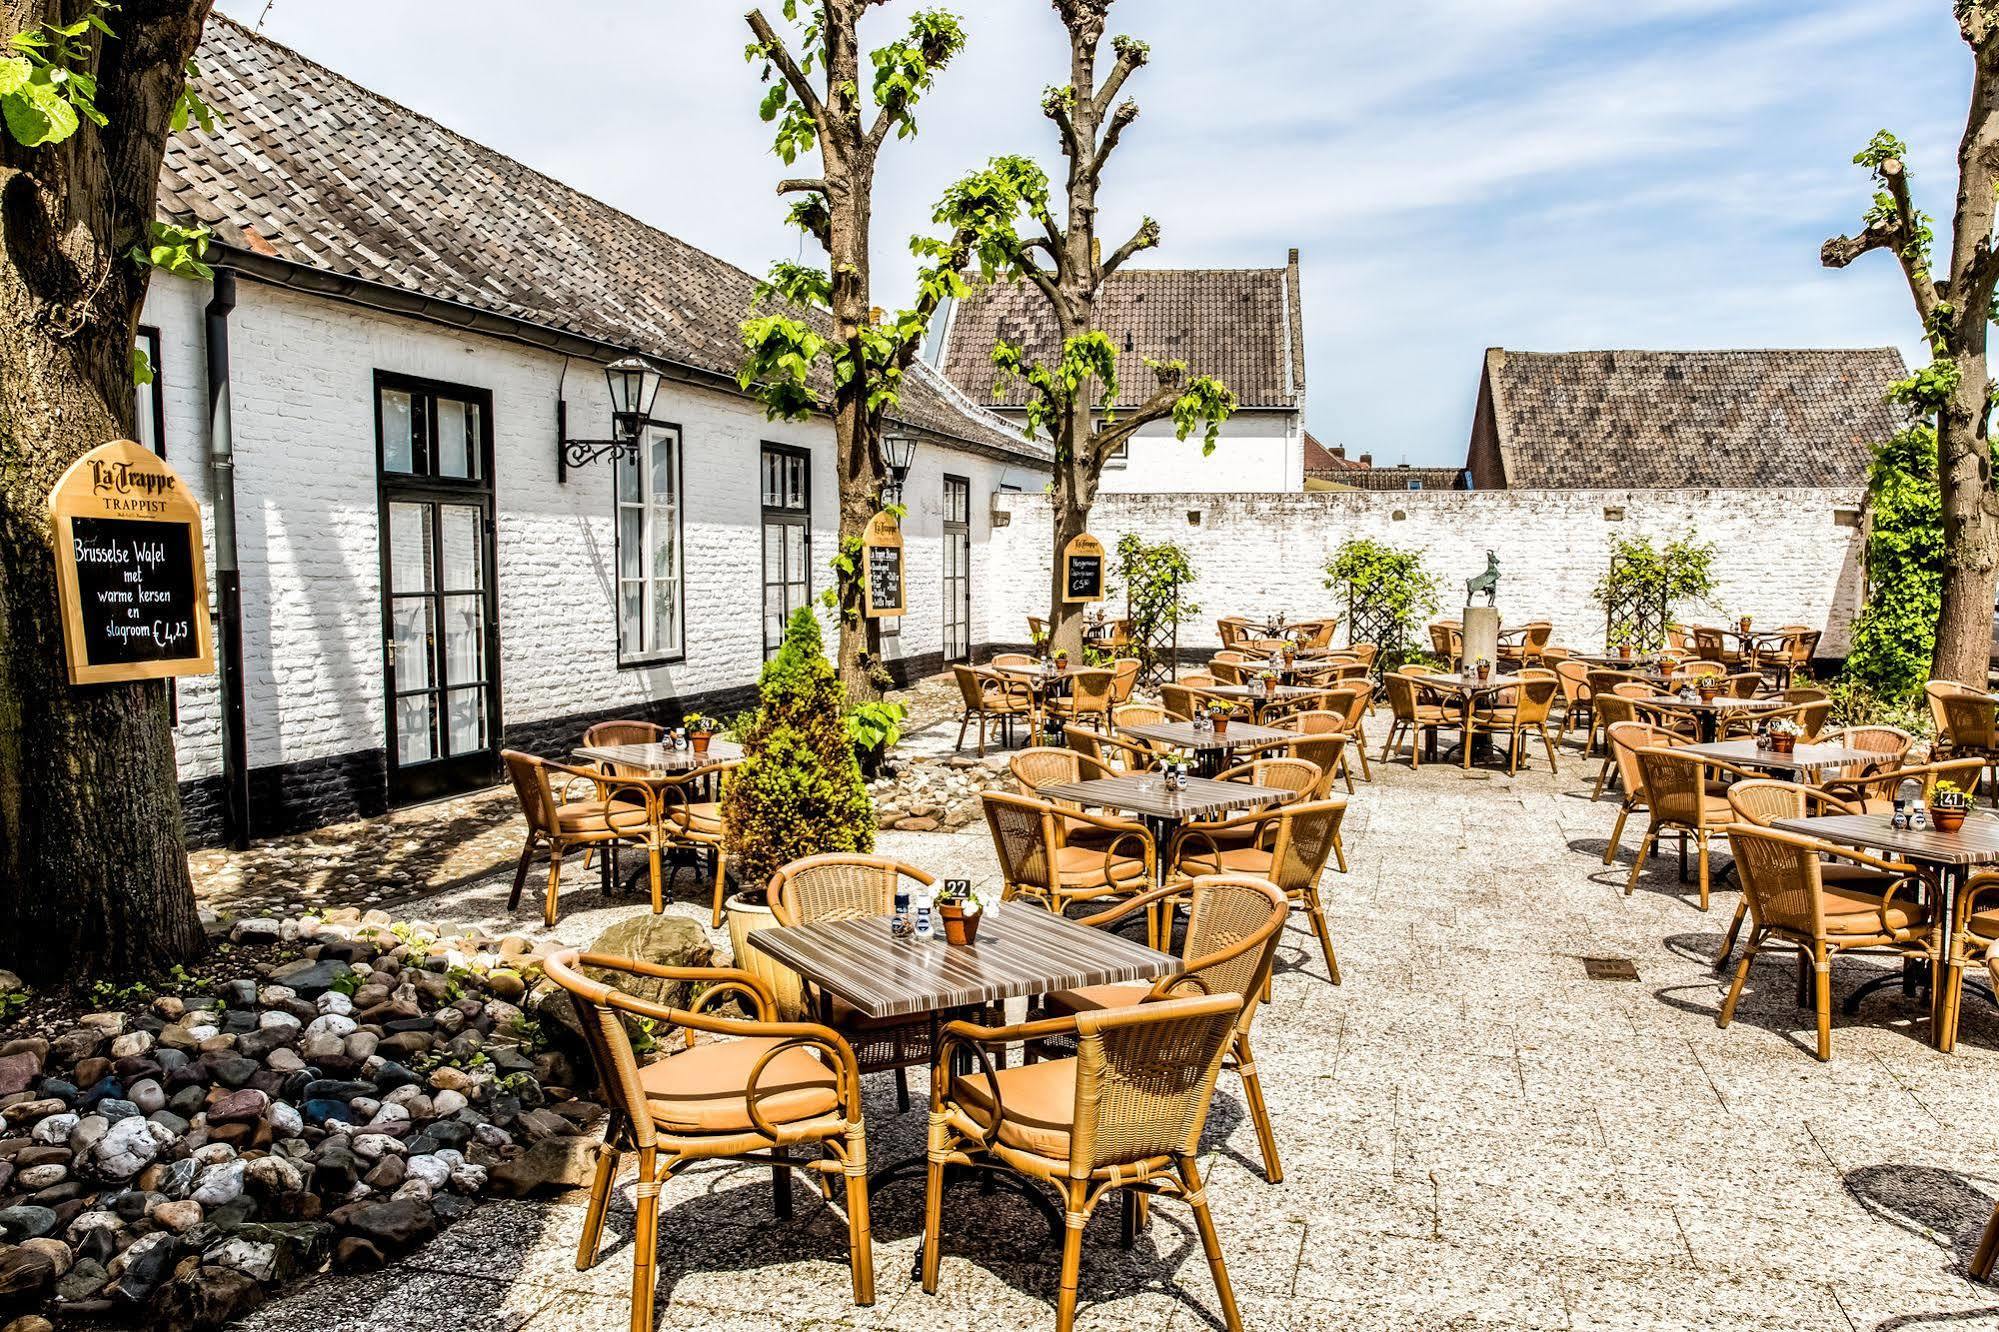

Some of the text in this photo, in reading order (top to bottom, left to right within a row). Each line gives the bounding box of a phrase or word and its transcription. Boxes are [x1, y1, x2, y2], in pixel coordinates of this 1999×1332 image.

[87, 460, 176, 496] La Trappe
[103, 497, 167, 512] TRAPPIST
[73, 538, 165, 571] Brusselse Wafel
[123, 565, 143, 583] met
[97, 584, 171, 603] warme kersen
[127, 607, 140, 619] en
[106, 619, 188, 647] slagroom €4,25
[1944, 793, 1958, 806] 41
[947, 880, 967, 897] 22
